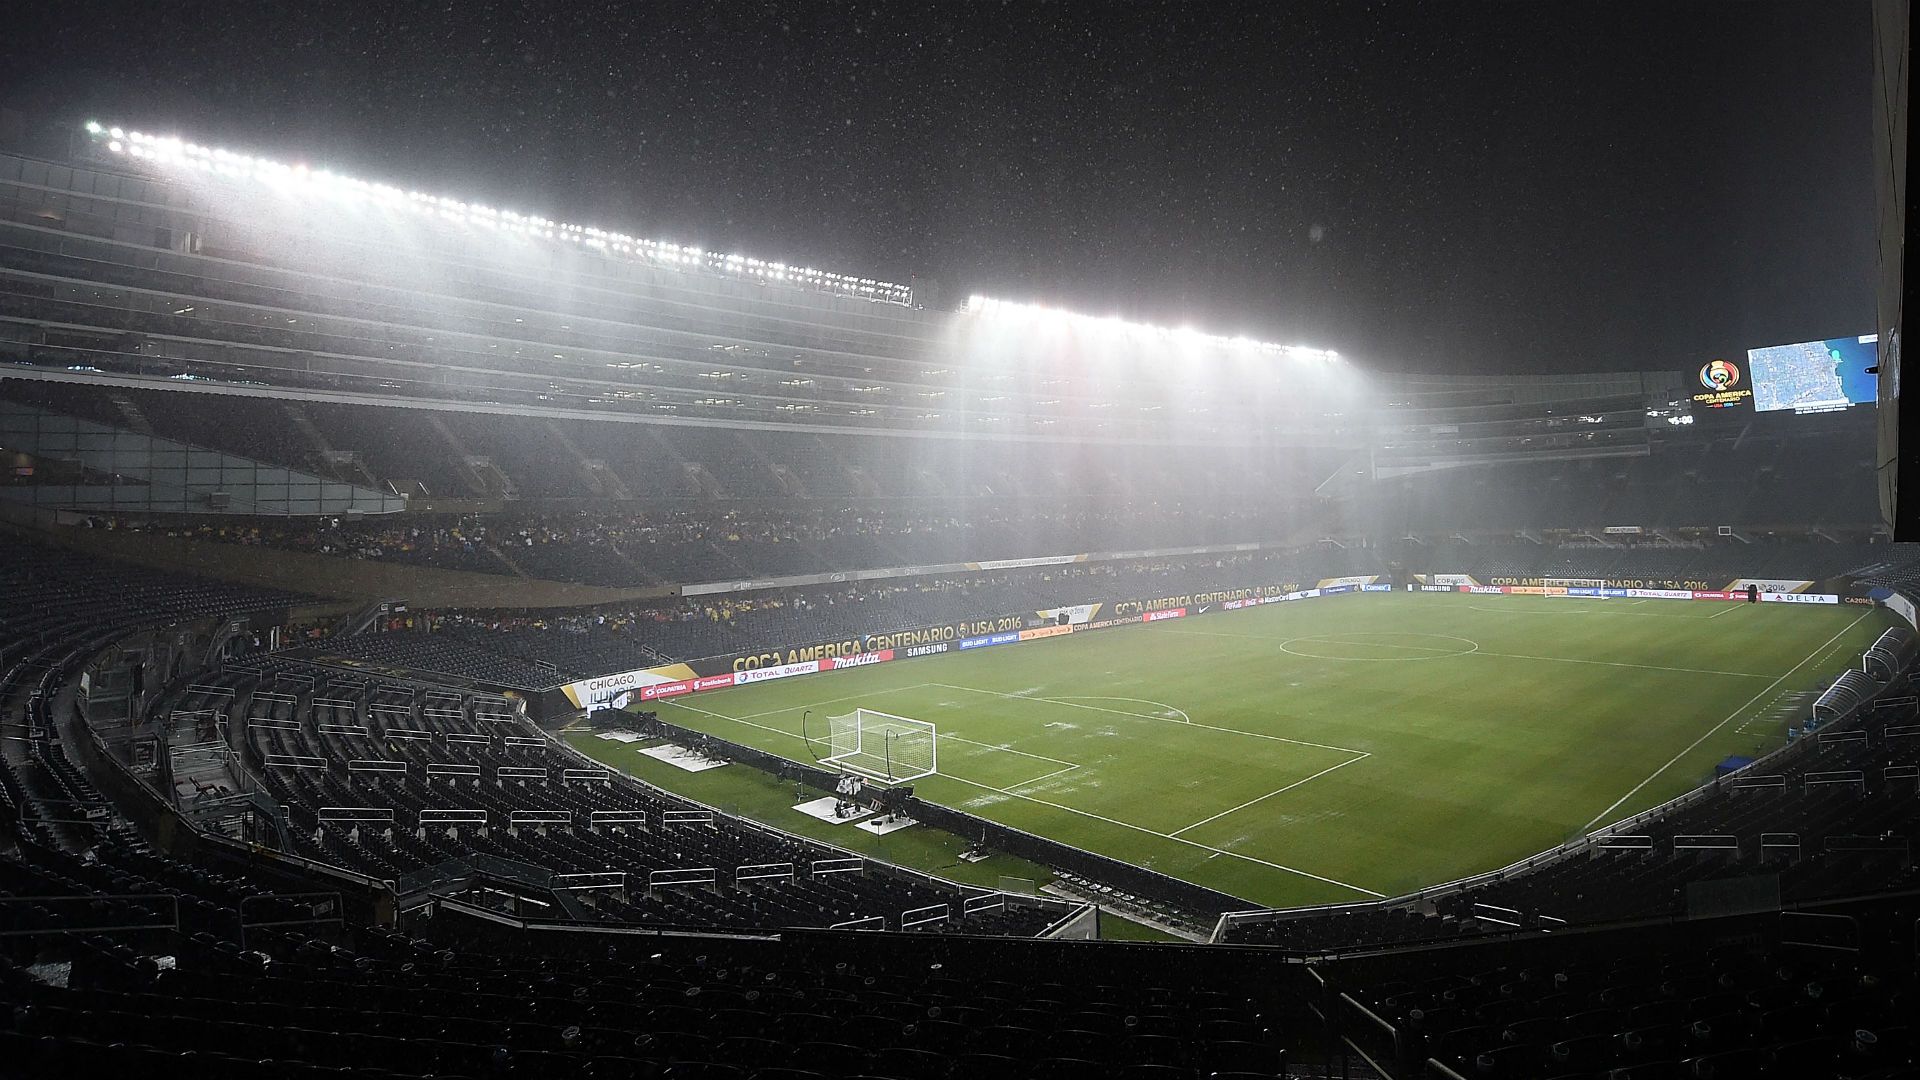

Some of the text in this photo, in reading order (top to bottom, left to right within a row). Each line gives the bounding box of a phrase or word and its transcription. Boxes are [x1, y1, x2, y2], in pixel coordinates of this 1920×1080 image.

[1715, 390, 1752, 399] AMERICA
[1490, 577, 1519, 586] COPA
[1521, 577, 1570, 587] AMERICA
[1574, 579, 1644, 589] CENTENARIO
[1683, 580, 1708, 591] 2016
[1768, 584, 1786, 592] 2016
[1146, 595, 1192, 611] AMERICA
[1194, 588, 1252, 605] CENTENARIO
[1264, 585, 1281, 597] USA
[1786, 594, 1825, 603] DELTA
[1073, 624, 1089, 632] COPA
[1089, 620, 1113, 630] AMERICA
[787, 639, 862, 664] AMERICA
[866, 626, 954, 651] CENTENARIO
[971, 620, 996, 635] USA
[998, 616, 1022, 632] 2016
[907, 643, 948, 657] SAMSUNG
[750, 664, 813, 679] TOTAL QUARTZ
[590, 674, 637, 691] CHICAGO,
[701, 677, 732, 687] Scotiabank
[655, 684, 687, 695] COLPATRIA
